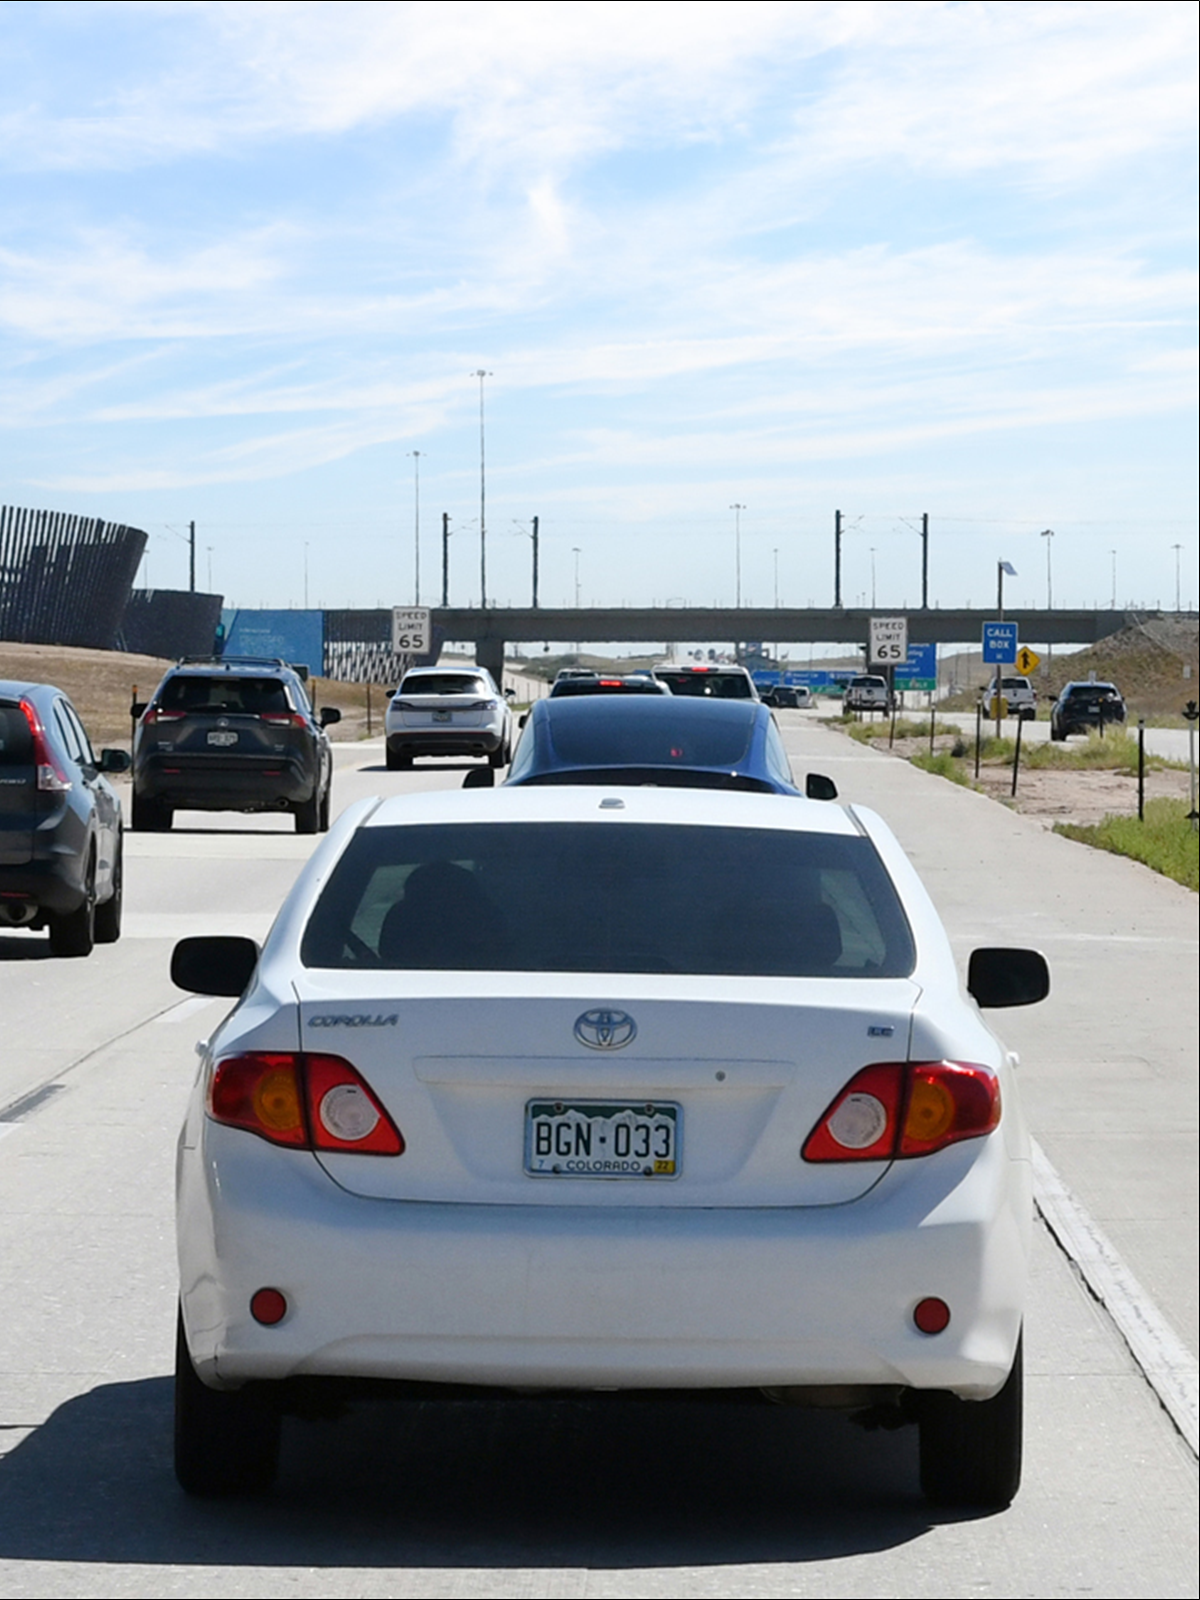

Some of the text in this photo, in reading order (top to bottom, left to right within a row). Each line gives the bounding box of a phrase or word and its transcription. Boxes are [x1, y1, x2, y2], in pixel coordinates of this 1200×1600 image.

[396, 611, 427, 620] SPEED
[398, 623, 422, 631] LIMIT
[873, 622, 904, 630] SPEED
[987, 628, 1013, 638] CALL
[399, 634, 423, 649] 65
[989, 640, 1010, 649] BOX
[877, 644, 901, 659] 65
[307, 1013, 399, 1027] COROLLA
[566, 1160, 641, 1172] COLORADO
[656, 1160, 669, 1170] 22
